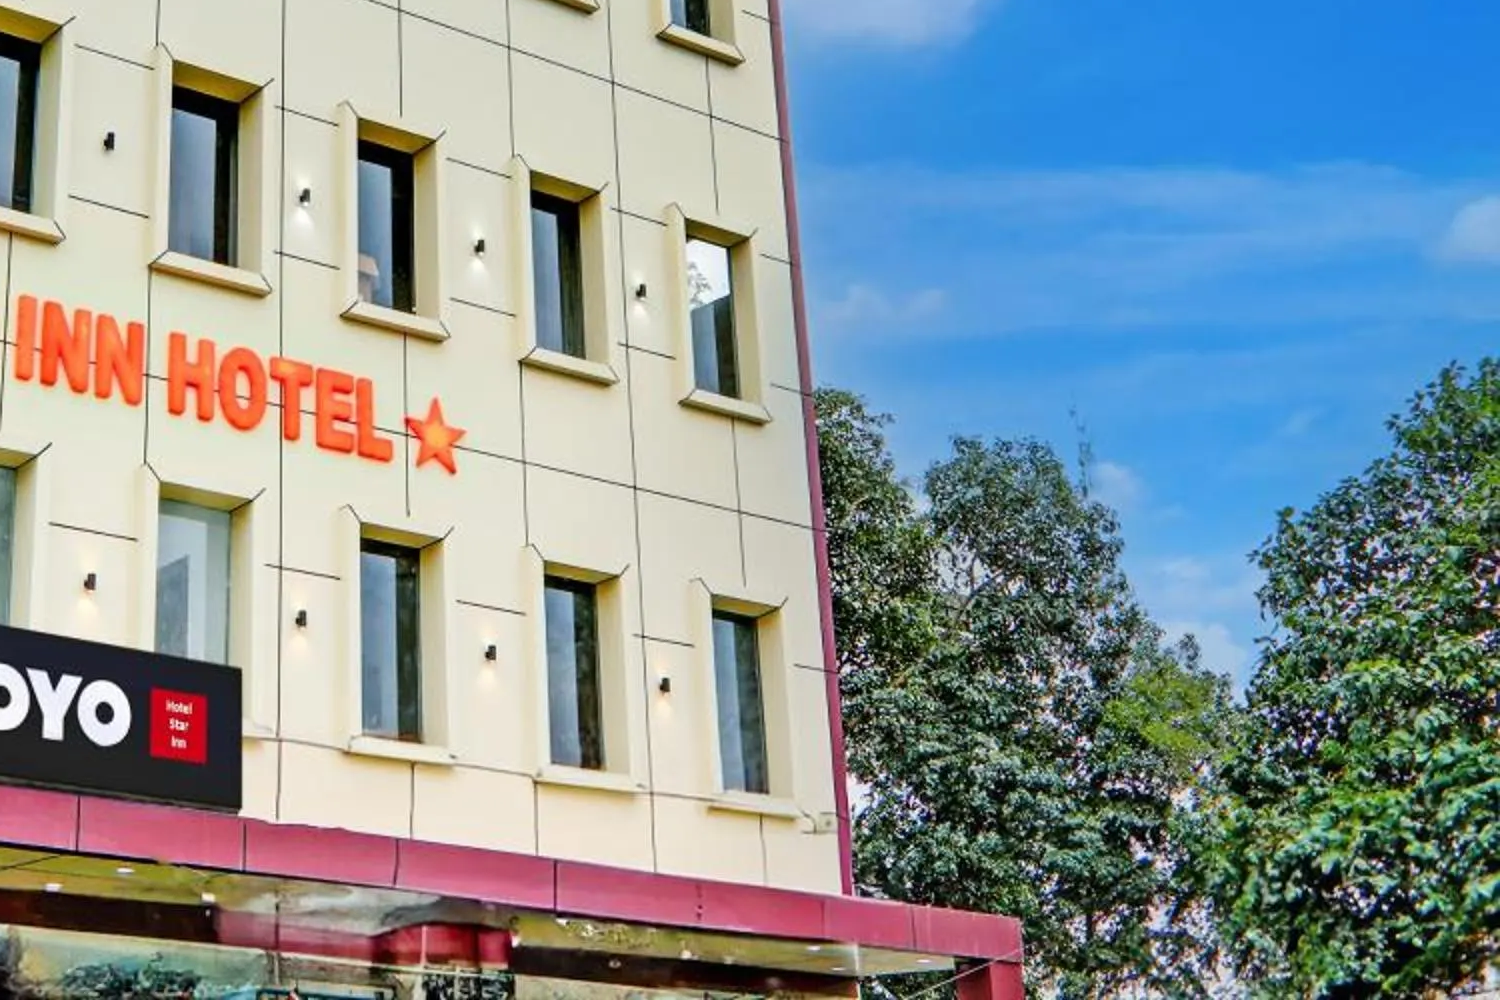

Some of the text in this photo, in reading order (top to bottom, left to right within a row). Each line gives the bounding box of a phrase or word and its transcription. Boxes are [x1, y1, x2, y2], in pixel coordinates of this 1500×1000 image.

[15, 294, 144, 406] INN
[167, 331, 393, 463] HOTEL
[165, 700, 193, 715] Hotel
[169, 717, 189, 731] Star
[171, 735, 187, 748] Inn
